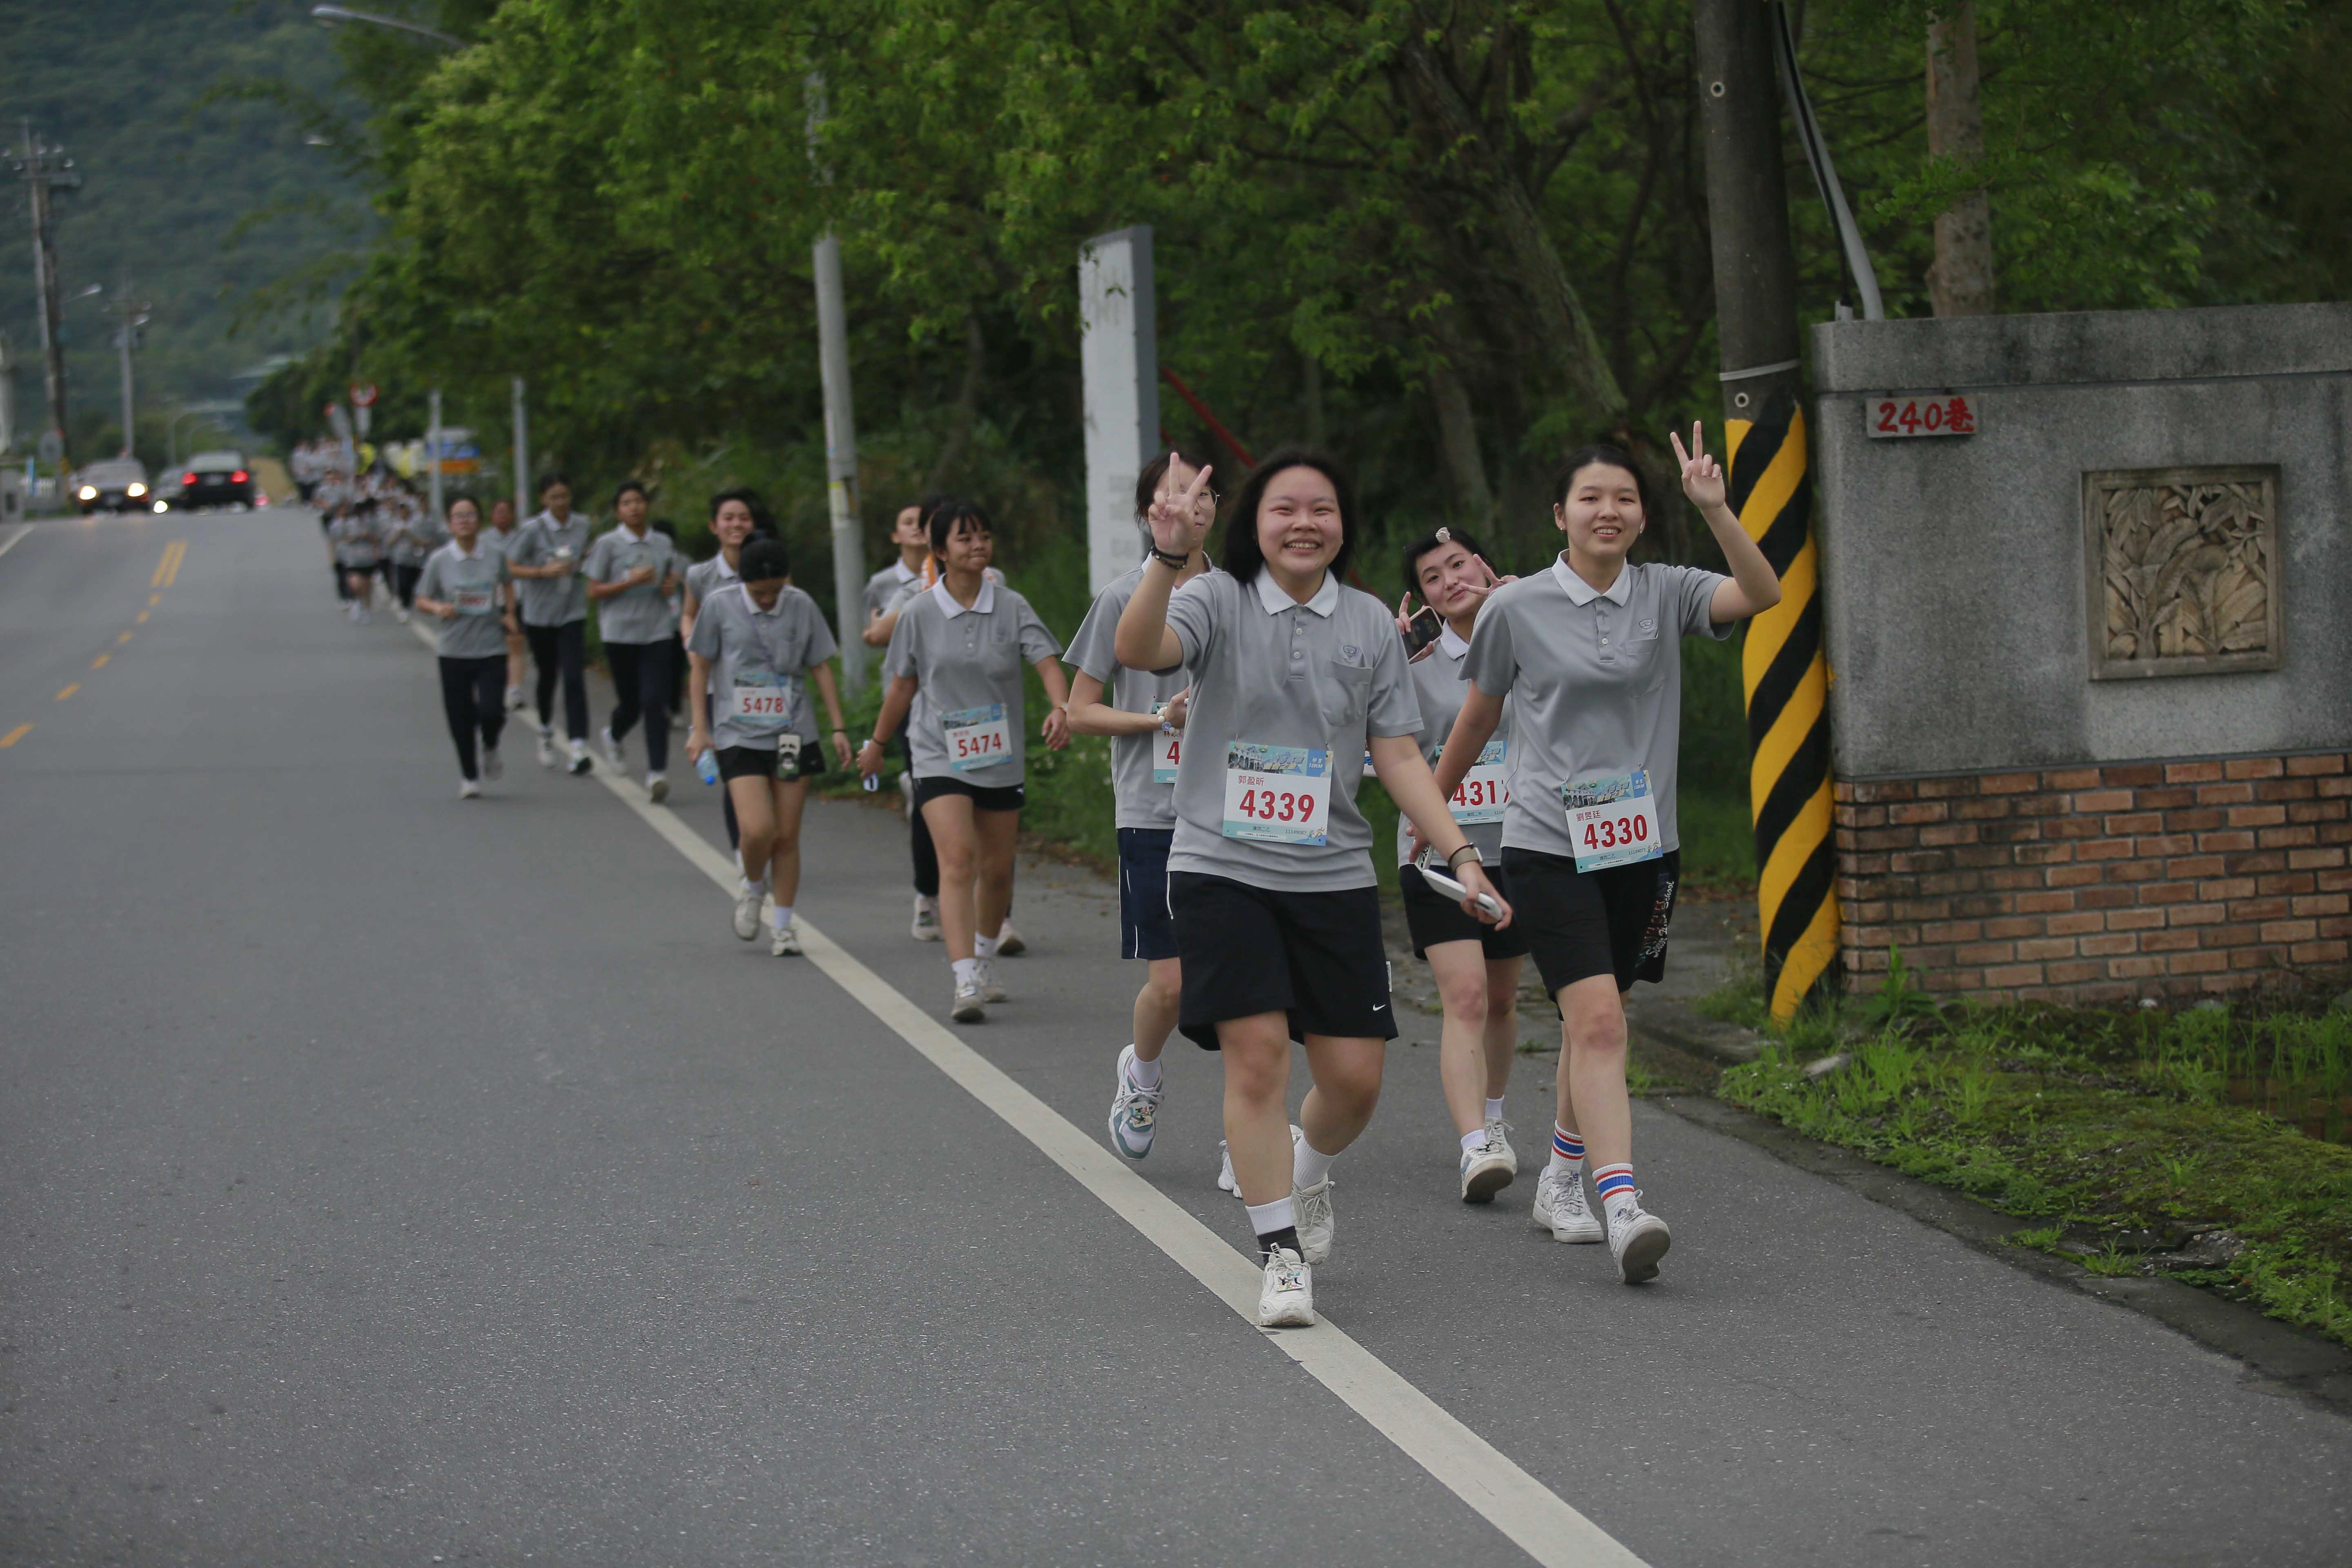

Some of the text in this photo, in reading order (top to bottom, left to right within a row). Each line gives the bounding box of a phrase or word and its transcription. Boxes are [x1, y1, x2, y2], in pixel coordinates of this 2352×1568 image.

[1877, 396, 1974, 434] 240巷
[742, 697, 784, 713] 5478
[958, 733, 1002, 757] 5474
[1239, 789, 1314, 822] 4339
[1584, 814, 1648, 850] 4330
[1664, 881, 1675, 909] School
